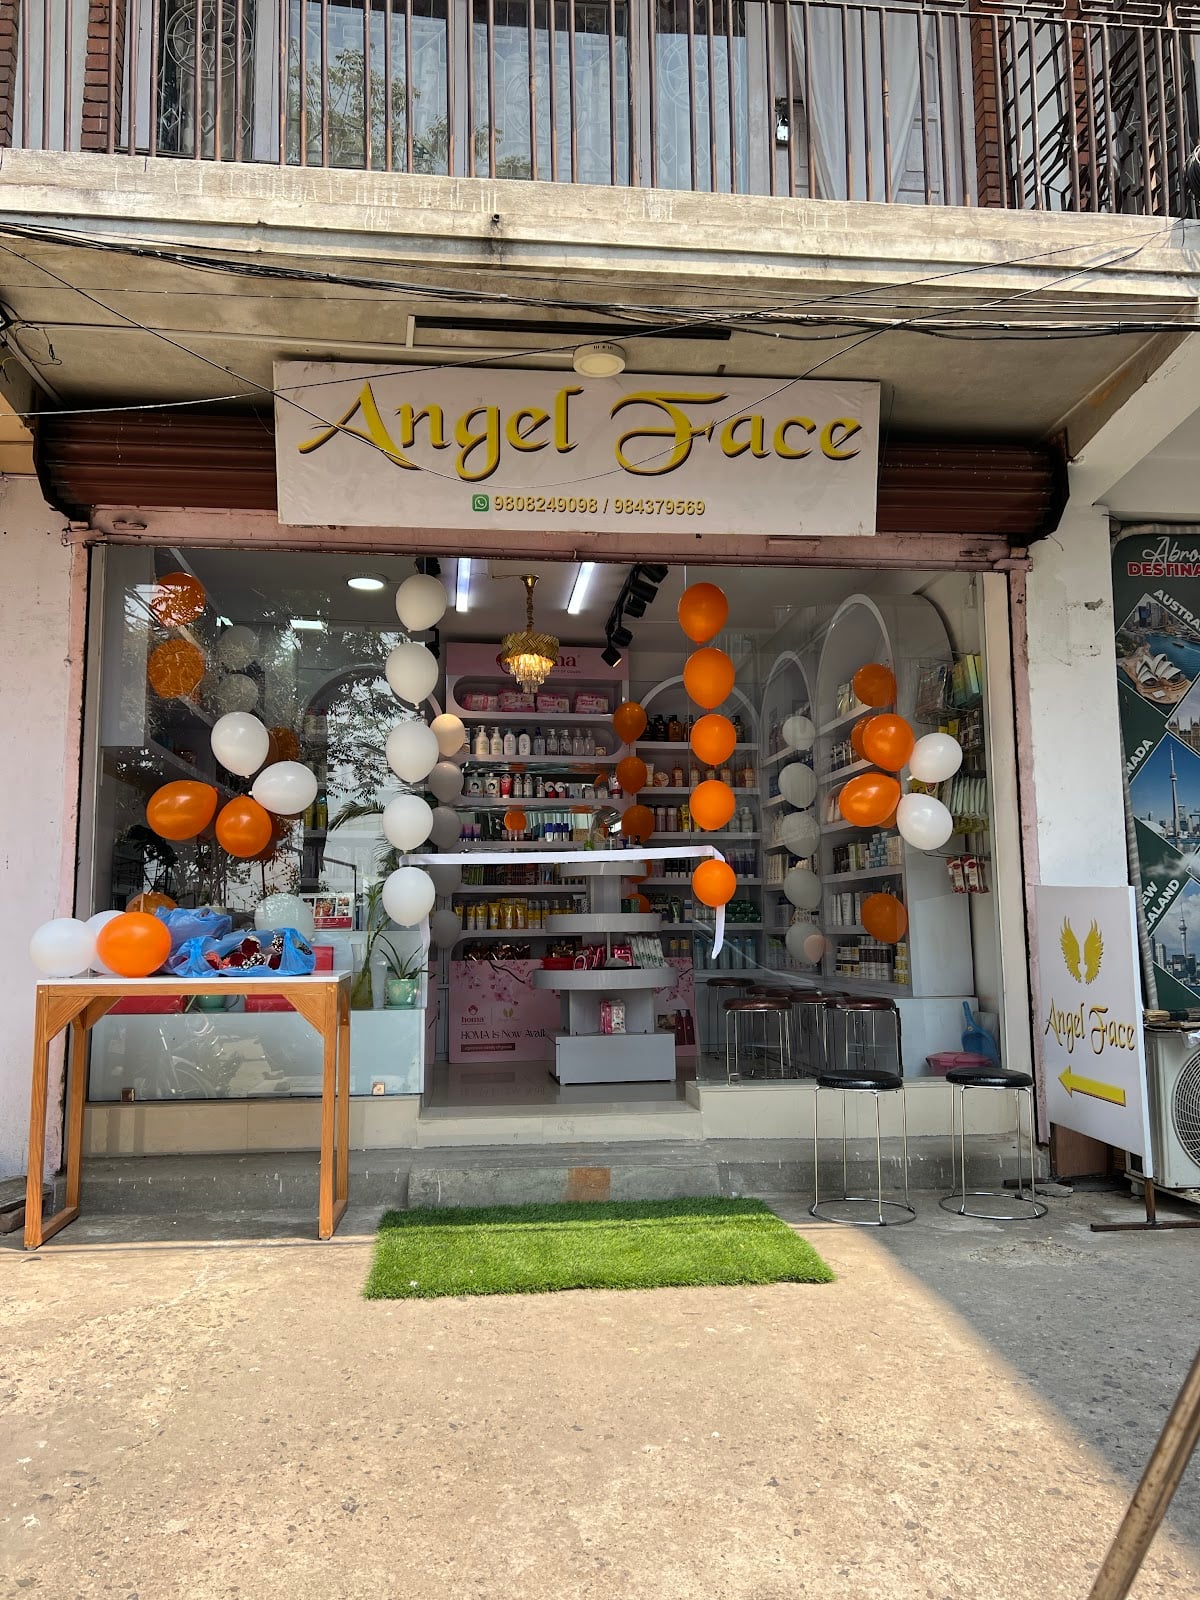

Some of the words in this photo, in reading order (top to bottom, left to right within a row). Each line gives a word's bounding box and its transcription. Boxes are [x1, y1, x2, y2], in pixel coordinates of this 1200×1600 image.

[299, 381, 583, 481] Angel
[608, 391, 861, 475] Face
[494, 495, 598, 514] 9808249098
[602, 498, 607, 514] /
[614, 498, 706, 516] 984379569
[1142, 536, 1200, 568] Abro
[1128, 562, 1200, 577] DESTINA
[1153, 589, 1200, 631] AUSTRA
[1126, 740, 1154, 777] NADA
[1142, 881, 1158, 908] EW
[1146, 879, 1180, 930] EALAND
[461, 1030, 490, 1040] HOMA
[525, 1028, 546, 1038] Avail
[1044, 997, 1085, 1054] Angel
[1089, 1005, 1135, 1055] Face
